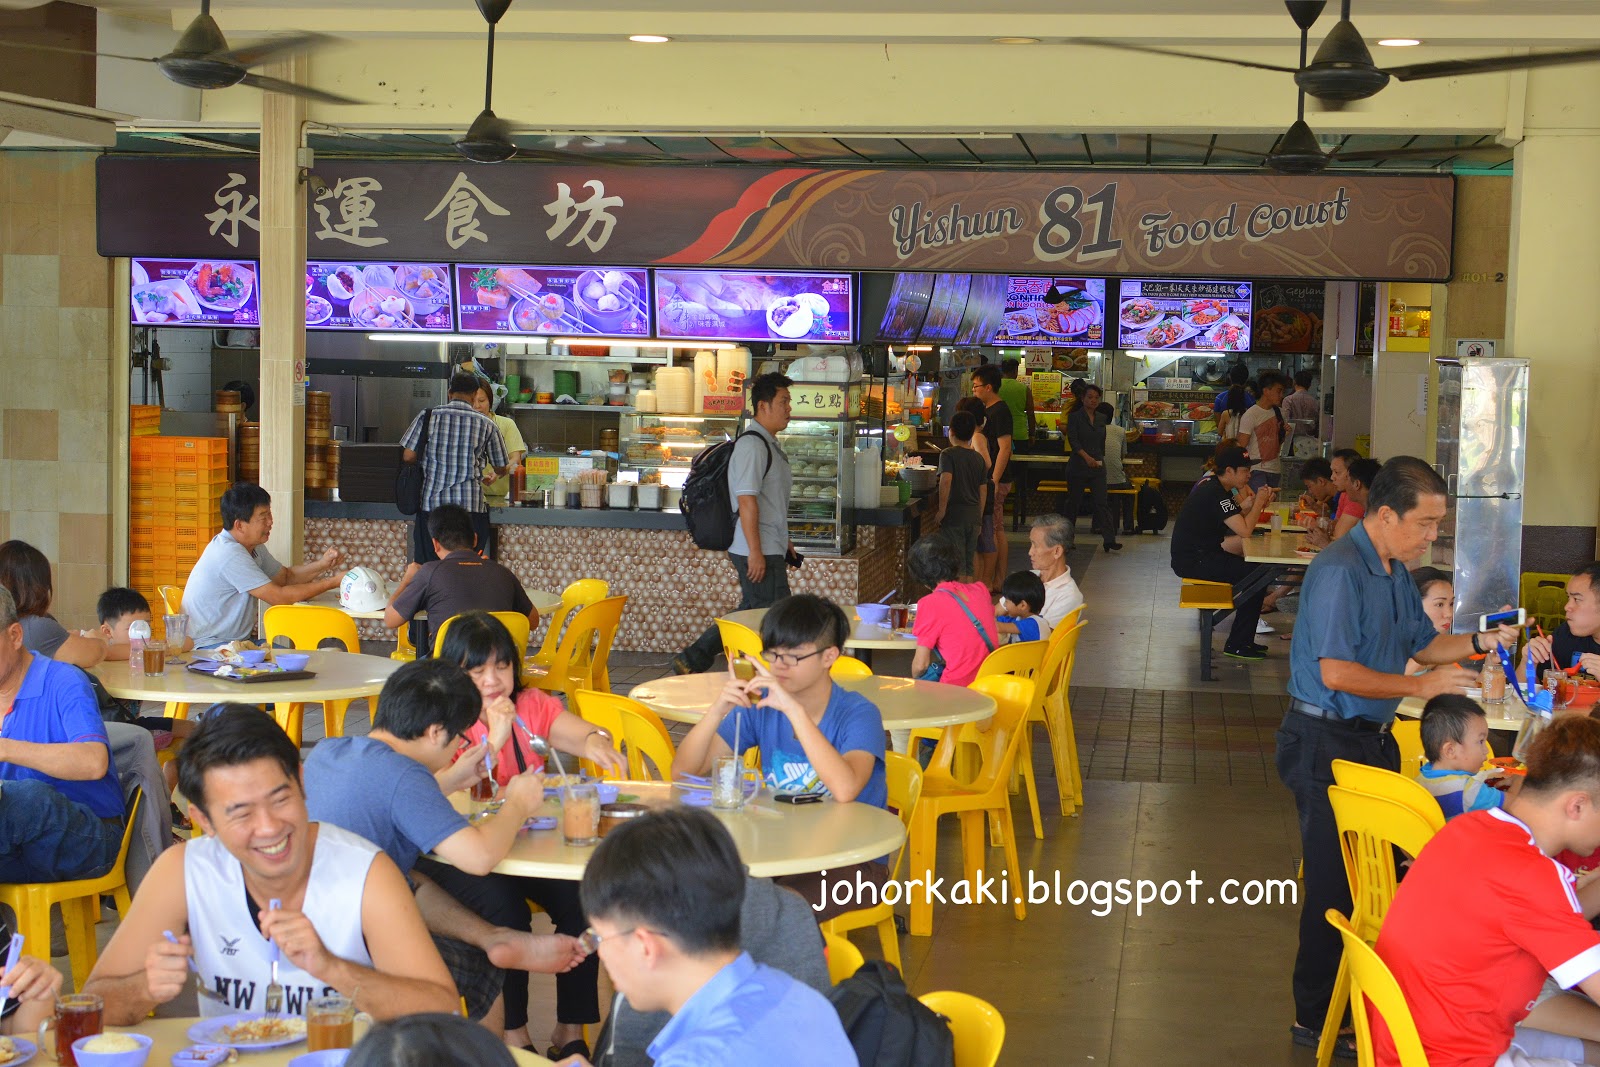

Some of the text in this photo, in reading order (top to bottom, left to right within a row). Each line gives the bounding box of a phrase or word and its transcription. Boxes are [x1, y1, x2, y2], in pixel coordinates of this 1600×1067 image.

[889, 182, 1350, 262] Yishun 81 Food Court
[1463, 272, 1508, 282] #01-2
